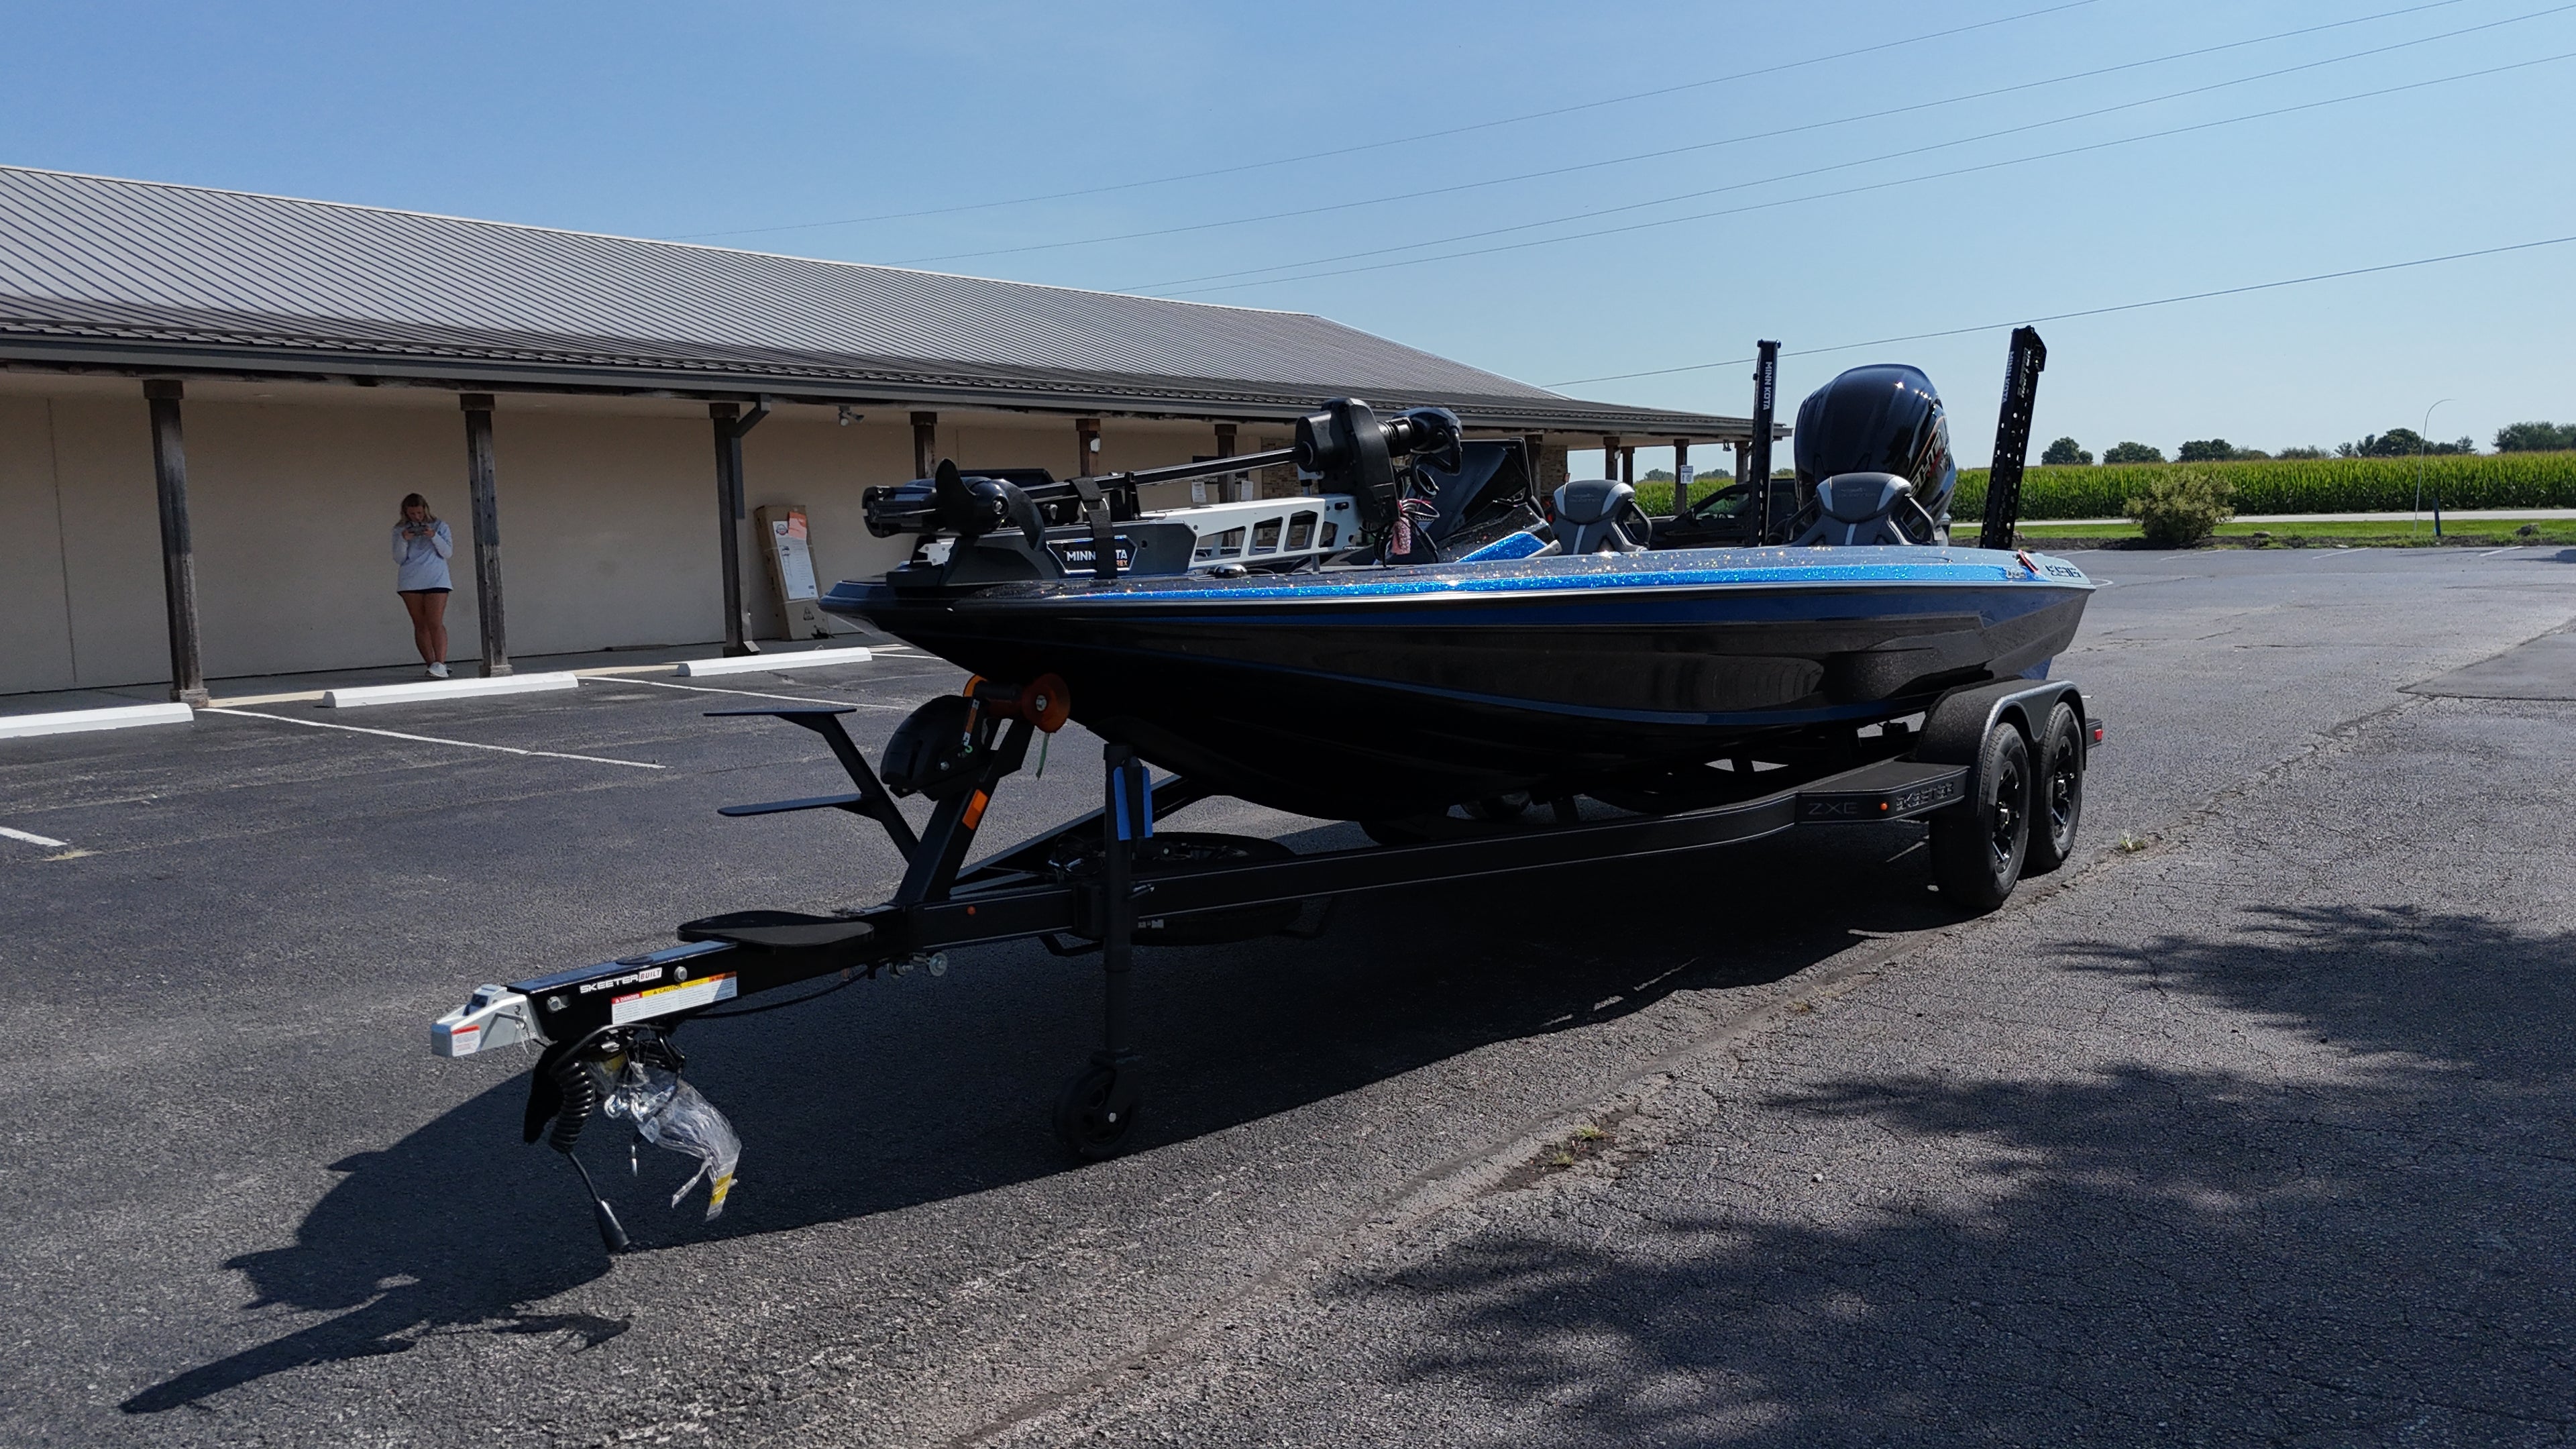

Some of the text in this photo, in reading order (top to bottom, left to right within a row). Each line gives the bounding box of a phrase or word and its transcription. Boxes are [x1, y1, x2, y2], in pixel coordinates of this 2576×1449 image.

[1762, 362, 1773, 411] MINN KOTA
[2002, 351, 2015, 403] MINN KOTA
[1066, 551, 1096, 561] MINN
[1808, 802, 1858, 815] ZXE
[1896, 782, 1955, 812] SKEETER
[579, 969, 662, 994] SKEETER BUILT
